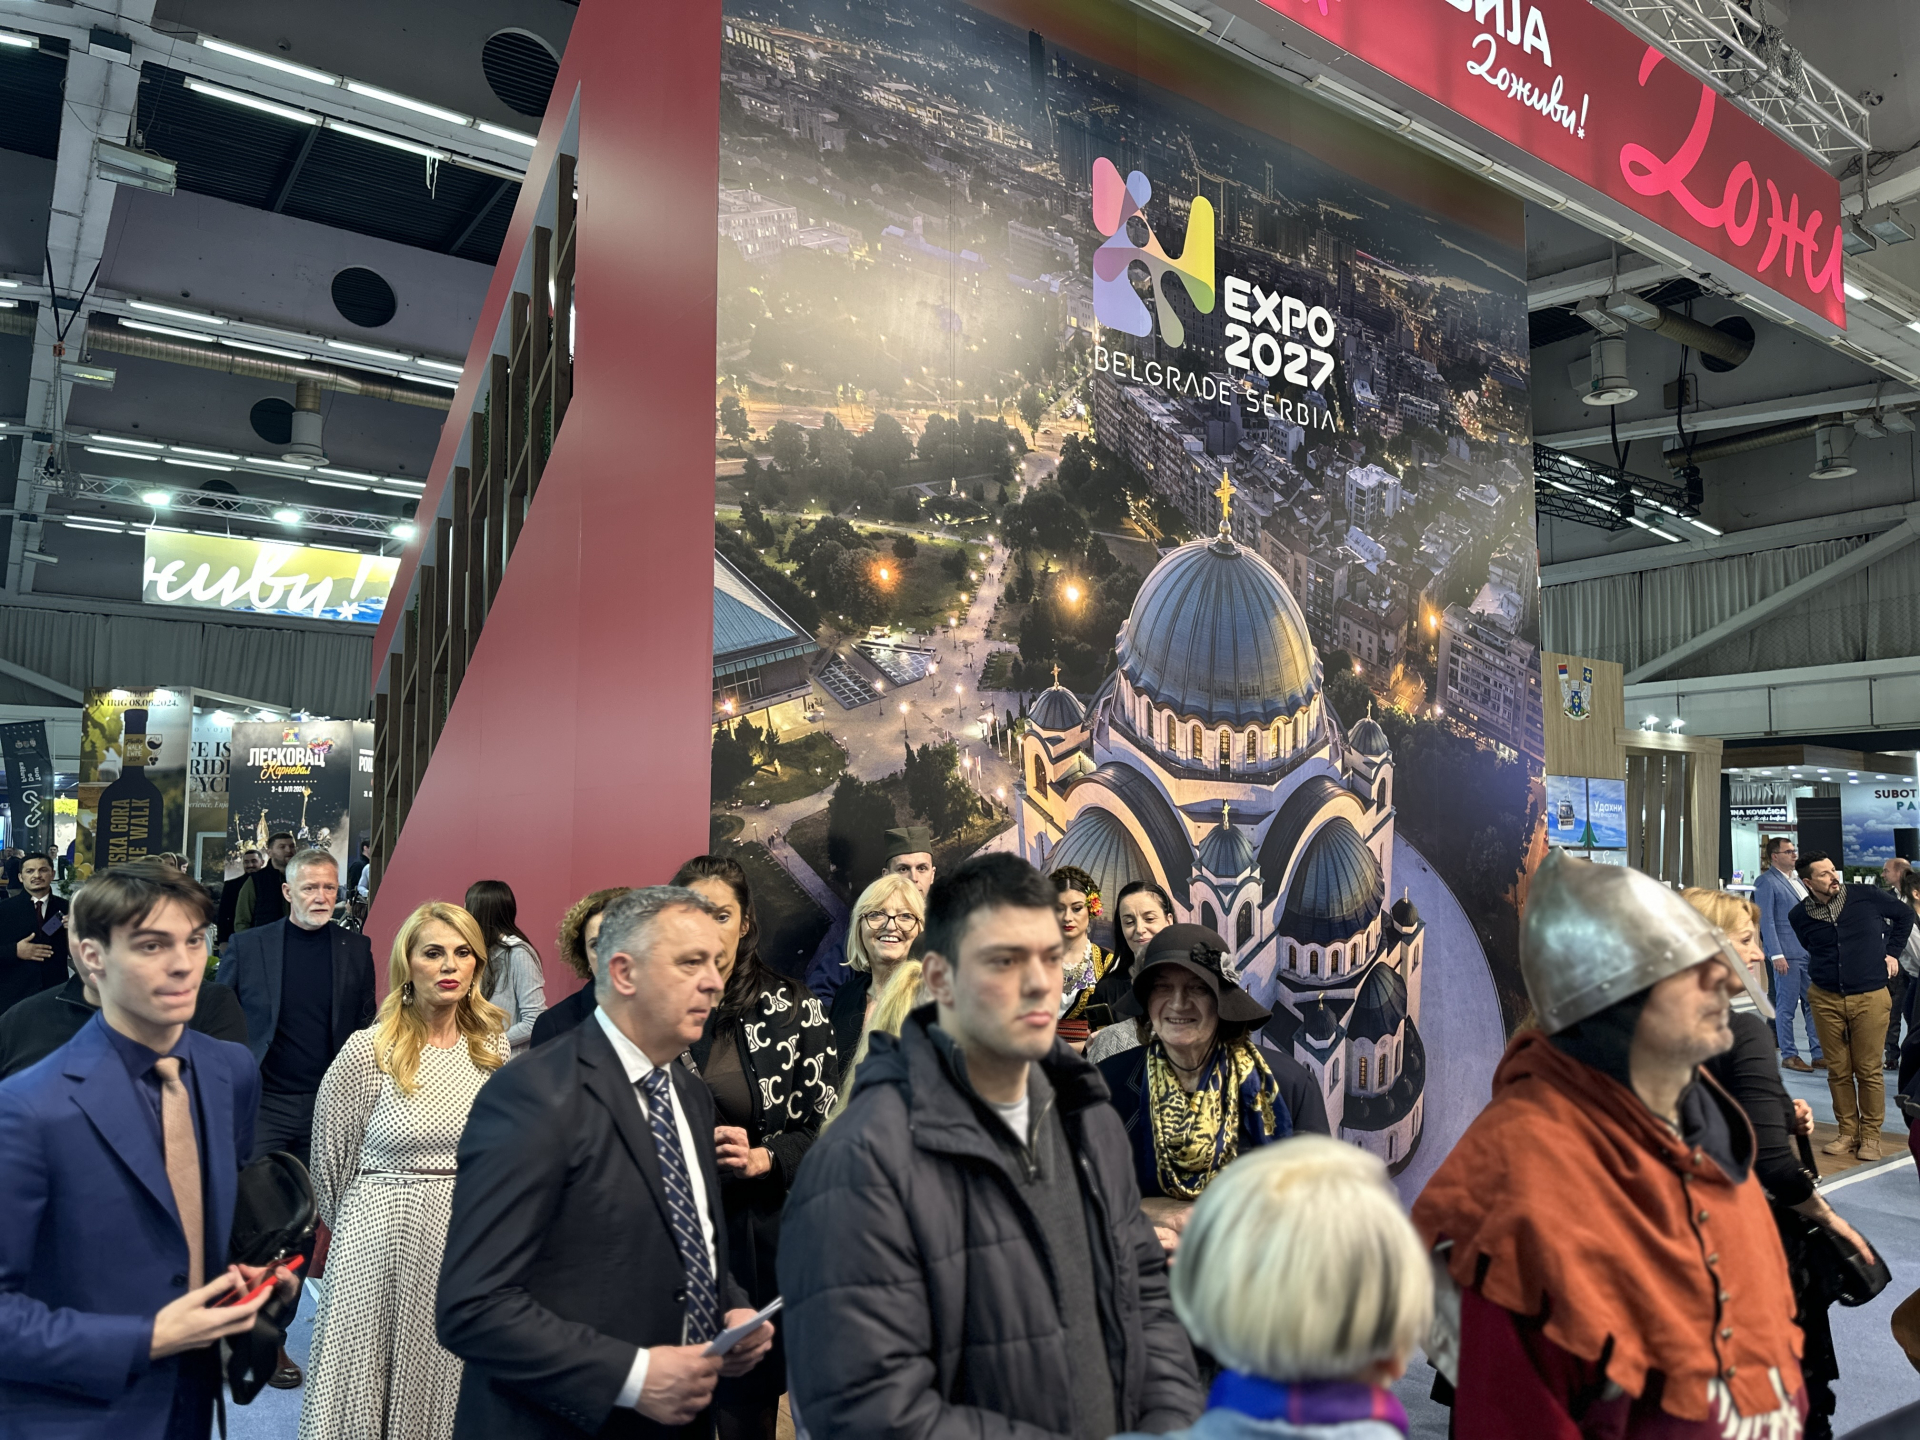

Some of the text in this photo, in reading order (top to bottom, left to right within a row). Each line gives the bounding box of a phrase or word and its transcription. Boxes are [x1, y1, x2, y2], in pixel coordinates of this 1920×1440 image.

[1446, 0, 1553, 68] ИЈА
[1224, 275, 1336, 348] EXPO
[1224, 323, 1336, 391] 2027
[1094, 345, 1336, 433] BELGRADE SERBIA
[215, 742, 231, 757] IS
[247, 747, 325, 768] ЛЕСКОВАЦ
[260, 761, 311, 780] Карневал
[1874, 788, 1917, 799] SUBOT
[1896, 800, 1917, 811] PA
[110, 799, 131, 832] GORA
[129, 799, 151, 840] WALK
[1746, 807, 1787, 816] KOVAČICA
